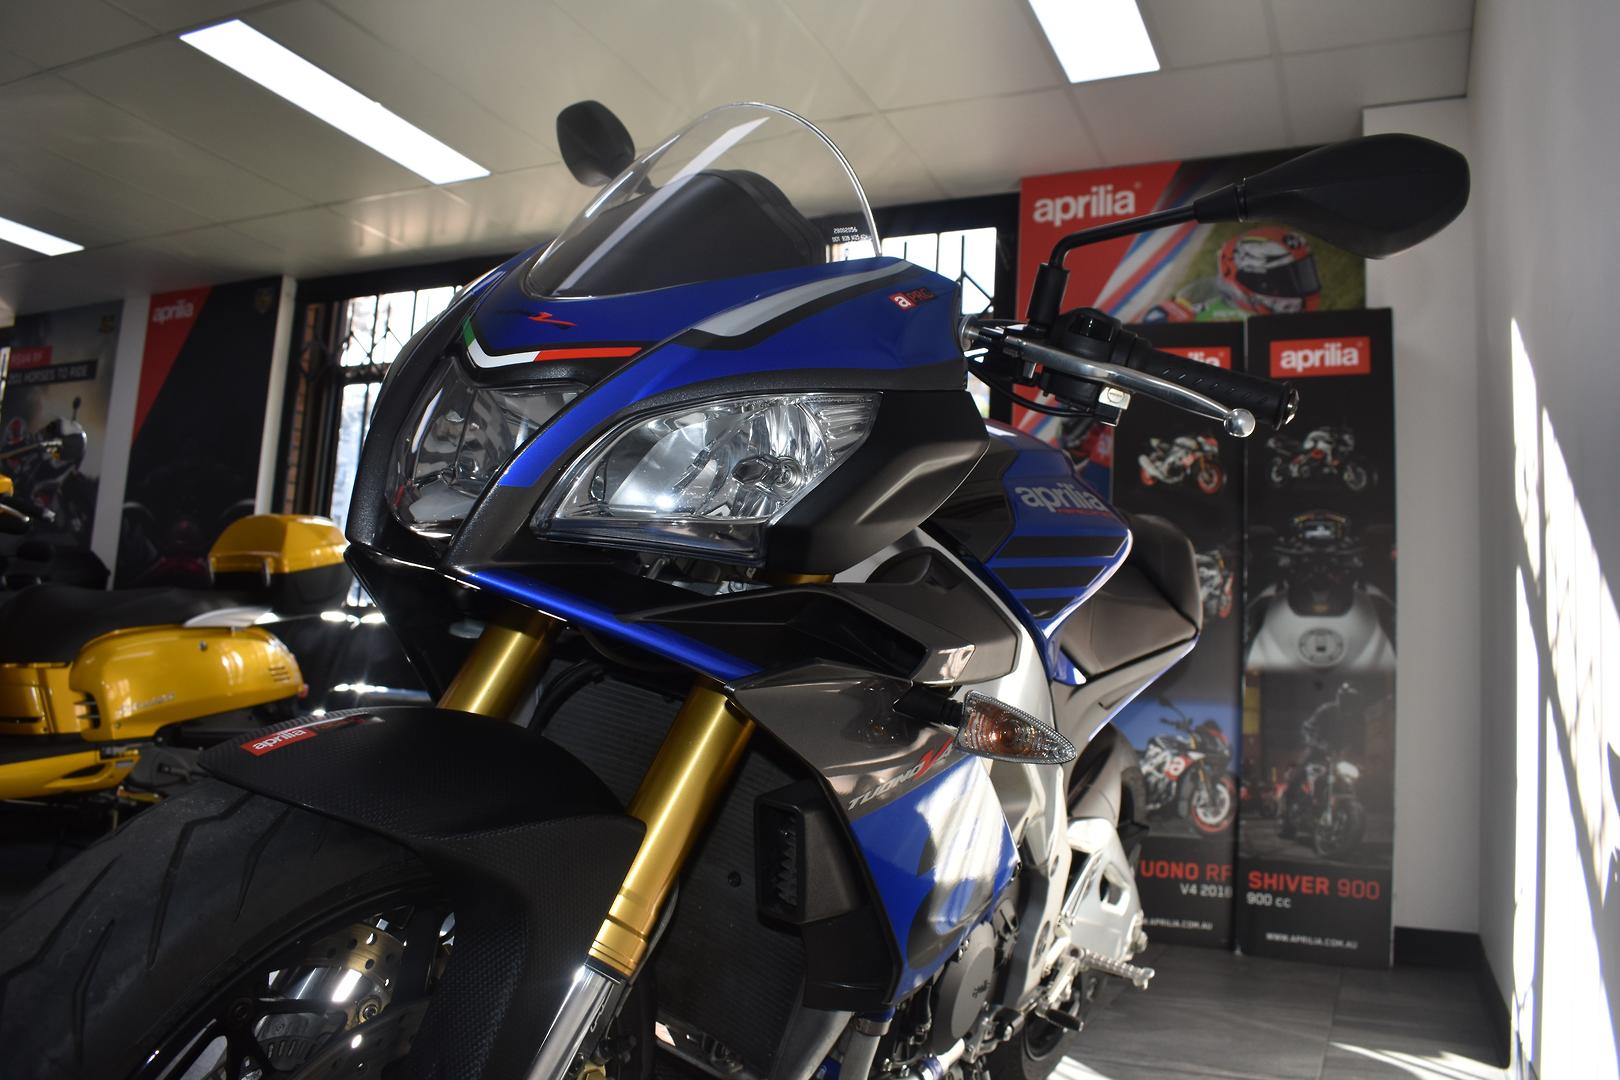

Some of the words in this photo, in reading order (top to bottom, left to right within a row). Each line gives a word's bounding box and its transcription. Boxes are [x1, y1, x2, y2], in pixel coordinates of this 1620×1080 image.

[1032, 184, 1136, 228] aprilia
[153, 299, 194, 325] aprilia
[1280, 342, 1359, 373] aprilia
[1014, 482, 1112, 513] aprilia
[252, 727, 307, 751] aprilia
[1139, 860, 1200, 881] UONO
[1180, 883, 1198, 896] V4
[1247, 869, 1330, 897] SHIVER
[1337, 878, 1381, 901] 900
[1246, 891, 1273, 907] 900
